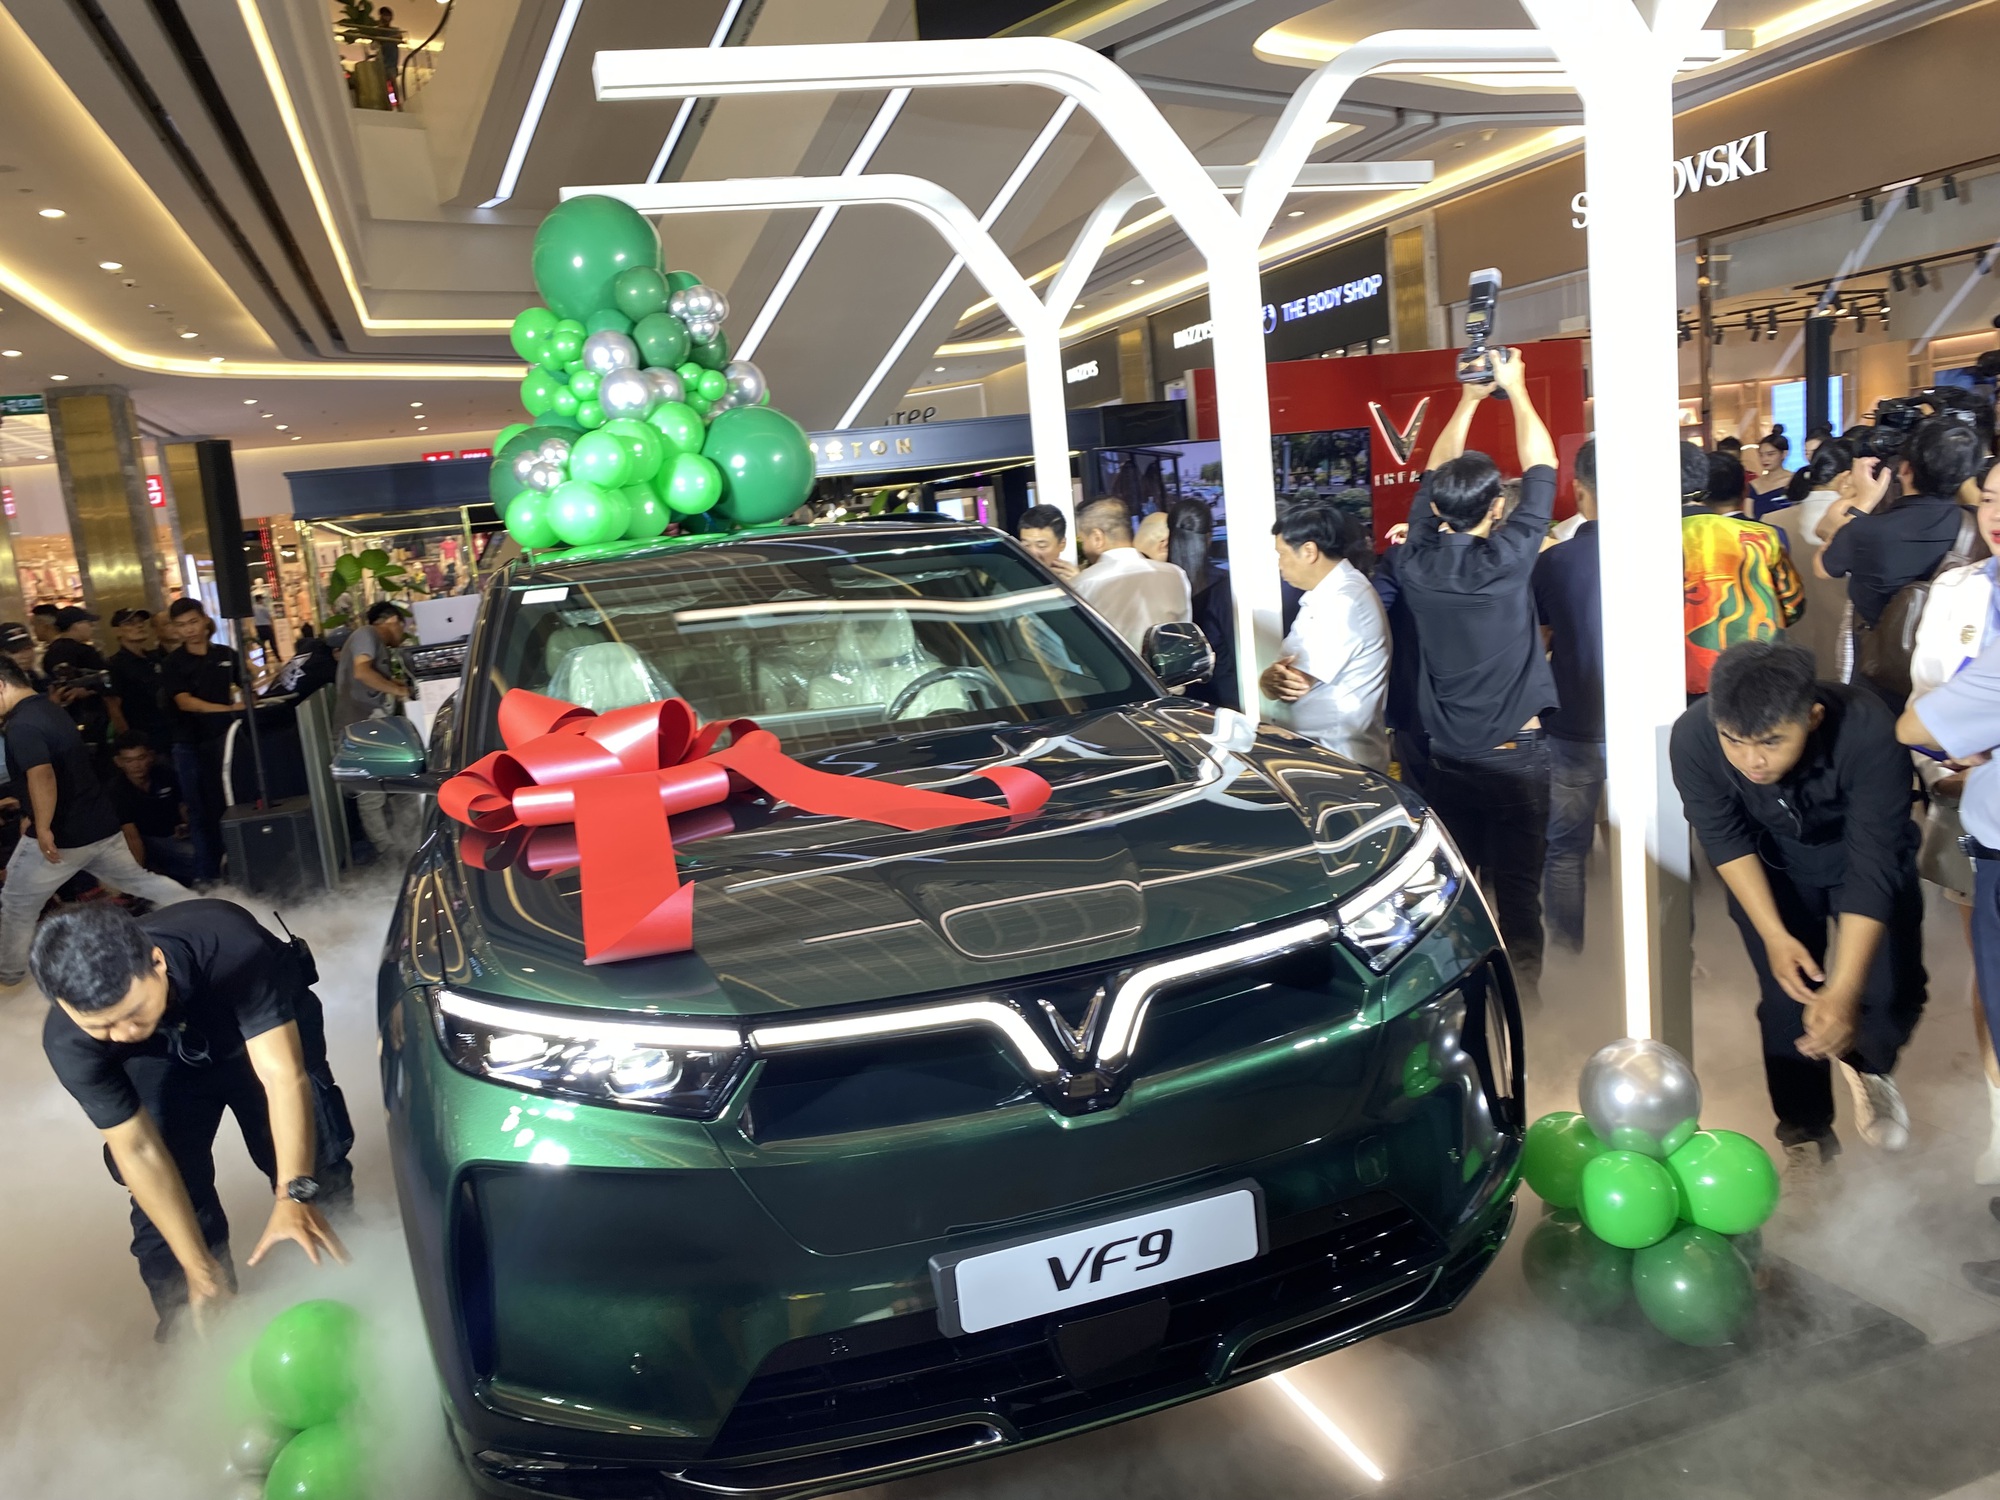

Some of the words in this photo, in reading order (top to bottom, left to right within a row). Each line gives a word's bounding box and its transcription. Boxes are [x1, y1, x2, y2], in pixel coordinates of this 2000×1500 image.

[1571, 131, 1768, 229] SOVSKI
[1281, 298, 1306, 322] THE
[1308, 286, 1343, 314] BODY
[1343, 274, 1383, 304] SHOP
[1047, 1228, 1173, 1292] VF9
